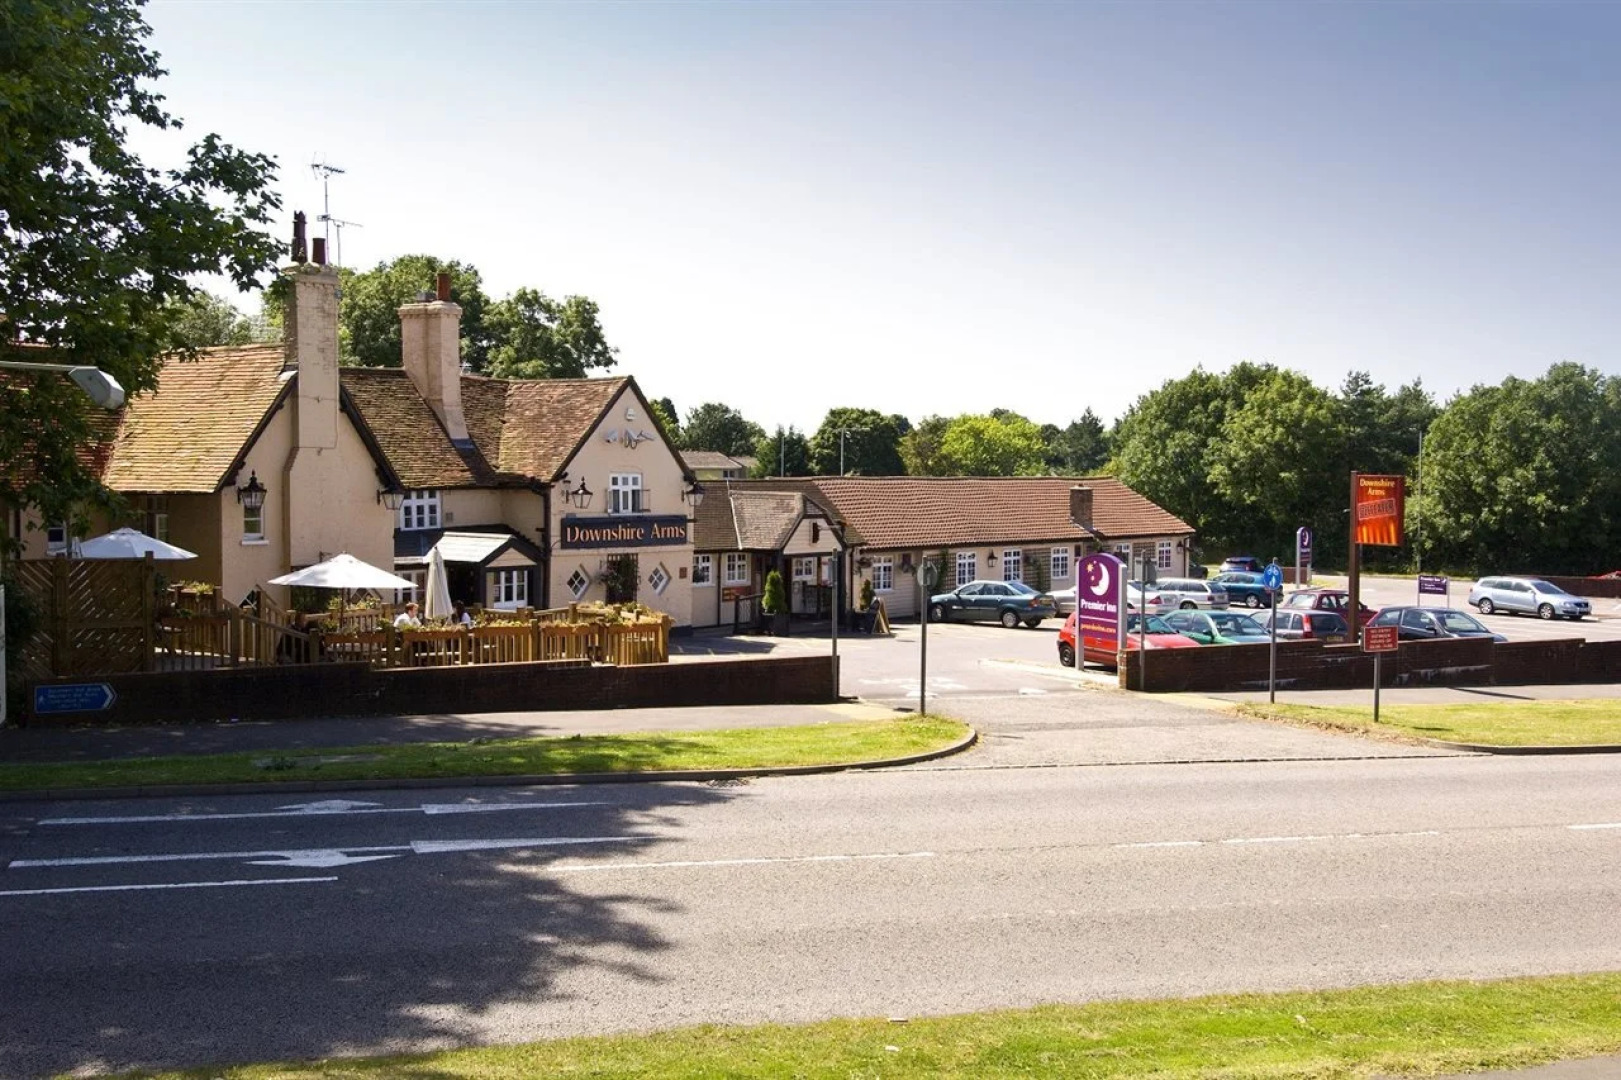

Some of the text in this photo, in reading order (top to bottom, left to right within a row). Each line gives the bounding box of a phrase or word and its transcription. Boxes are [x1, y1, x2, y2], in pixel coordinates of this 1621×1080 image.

[566, 523, 686, 542] Downshire Arms
[1080, 598, 1117, 613] Premier Inn
